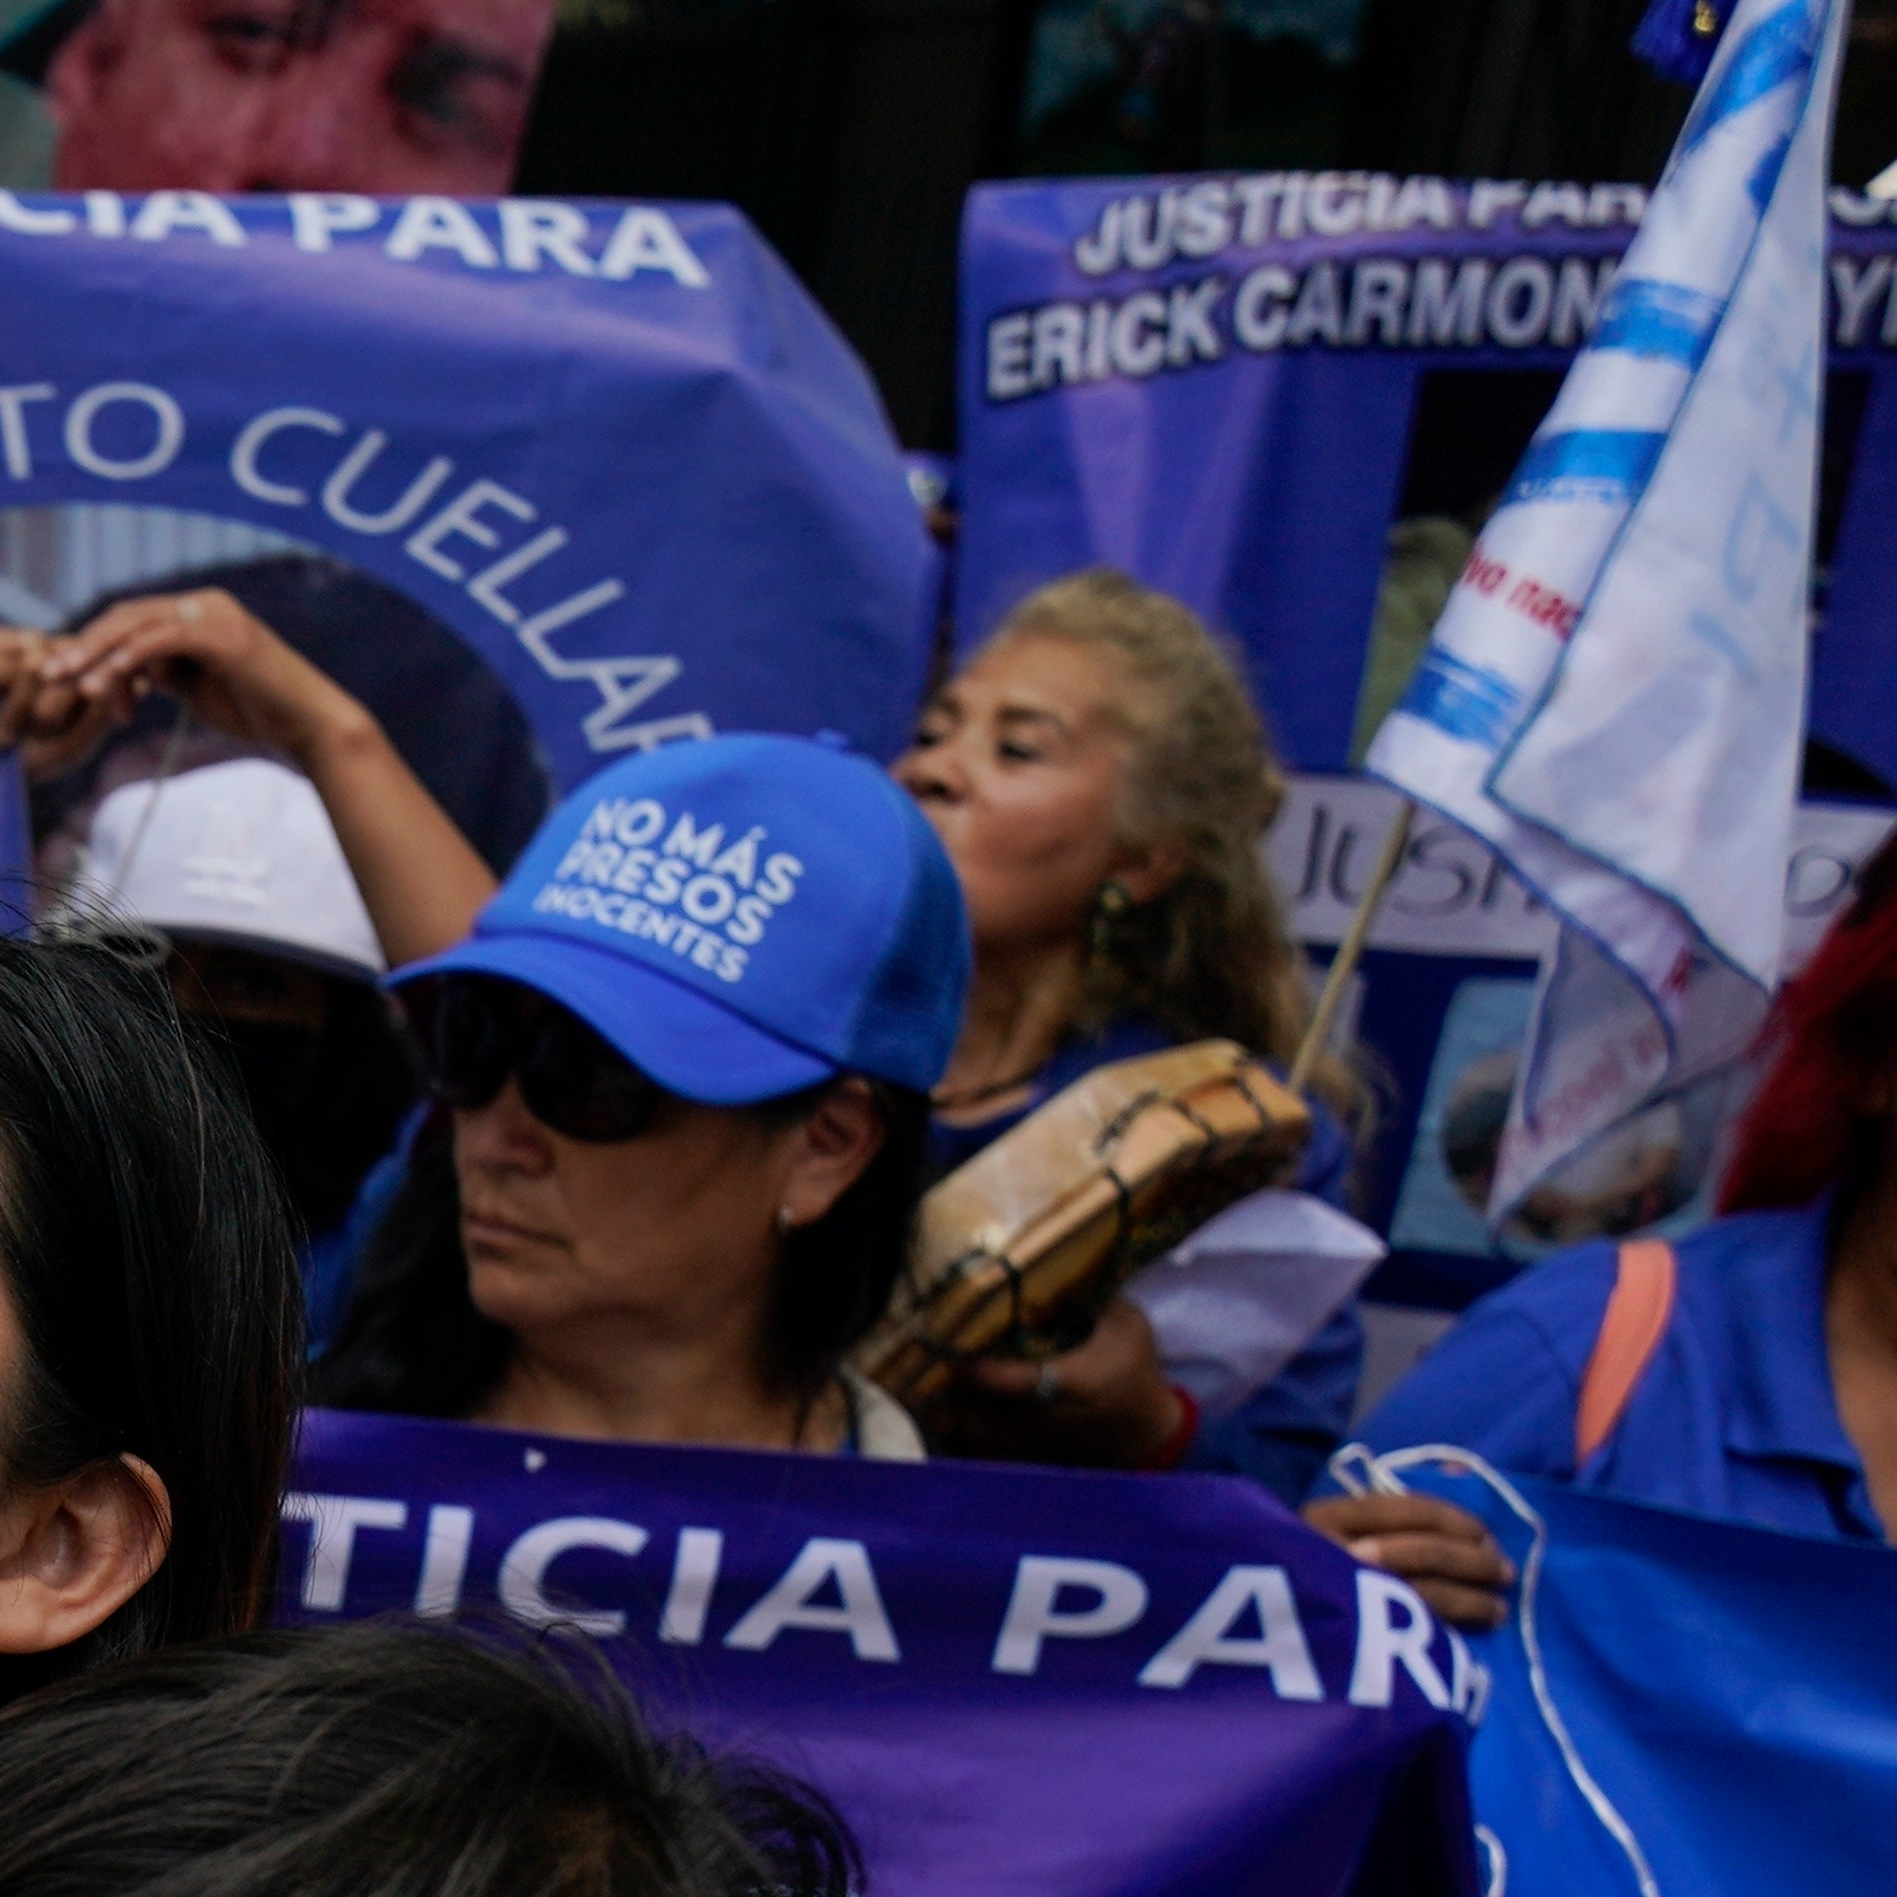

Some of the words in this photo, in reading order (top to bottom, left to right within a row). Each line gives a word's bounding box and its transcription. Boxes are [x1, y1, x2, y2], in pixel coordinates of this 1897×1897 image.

[290, 194, 710, 289] PARA
[1076, 170, 1450, 278] JUSTICIA
[986, 281, 1222, 400] ERICK
[555, 838, 773, 946] PRESOS
[580, 797, 667, 849] NO
[661, 811, 805, 906] MÁS
[530, 881, 750, 983] INOCENTES
